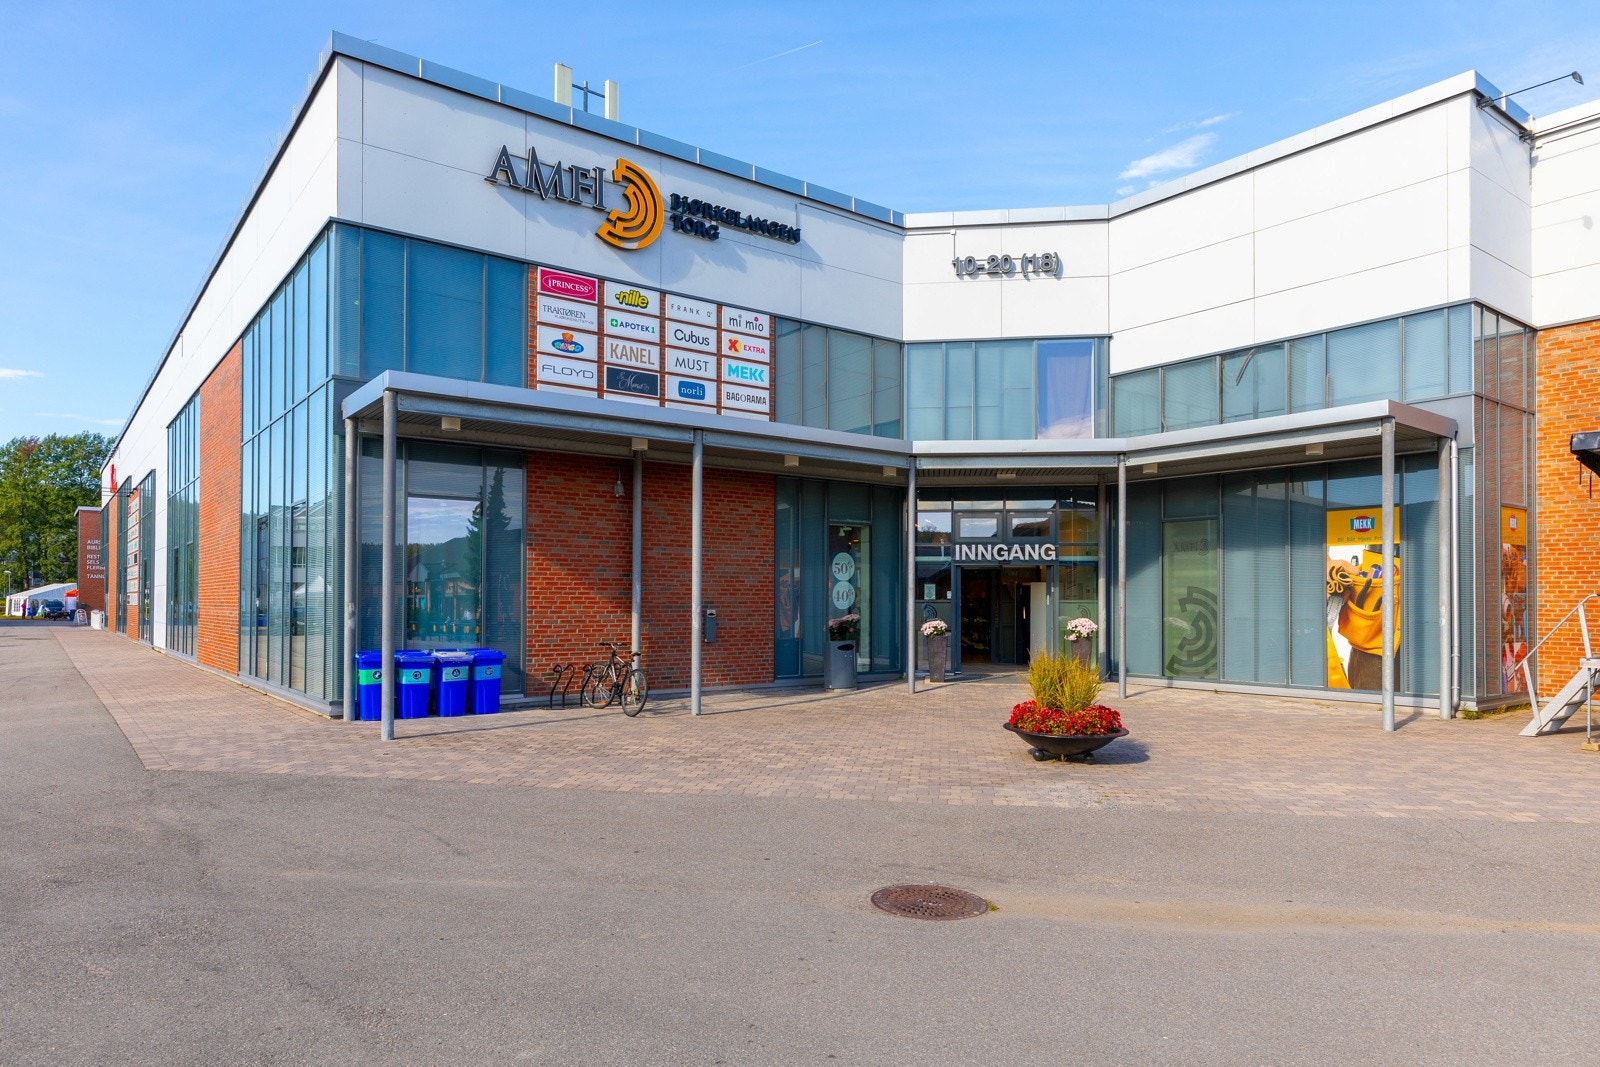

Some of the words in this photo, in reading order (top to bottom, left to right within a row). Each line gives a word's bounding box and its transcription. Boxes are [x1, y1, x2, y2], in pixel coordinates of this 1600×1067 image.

[484, 144, 607, 211] AMFI
[670, 192, 801, 244] BJØRKELANGEN
[669, 213, 720, 241] TORG
[952, 254, 1013, 276] 10-20
[1021, 252, 1060, 276] (18)
[618, 290, 649, 309] nille
[542, 304, 586, 320] TRAKTØREN
[670, 303, 700, 316] FRANK
[619, 321, 650, 333] APOTEK
[651, 326, 656, 334] 1
[729, 315, 742, 328] mi
[745, 316, 764, 332] mio
[674, 328, 710, 346] Cubus
[610, 342, 655, 366] KANEL
[743, 344, 766, 355] EXTRA
[541, 364, 594, 380] FLOYD
[674, 356, 709, 373] MUST
[680, 386, 703, 396] norli
[726, 391, 767, 406] BAGORAMA
[1353, 518, 1372, 530] MEKK
[955, 543, 1056, 561] INNGANG
